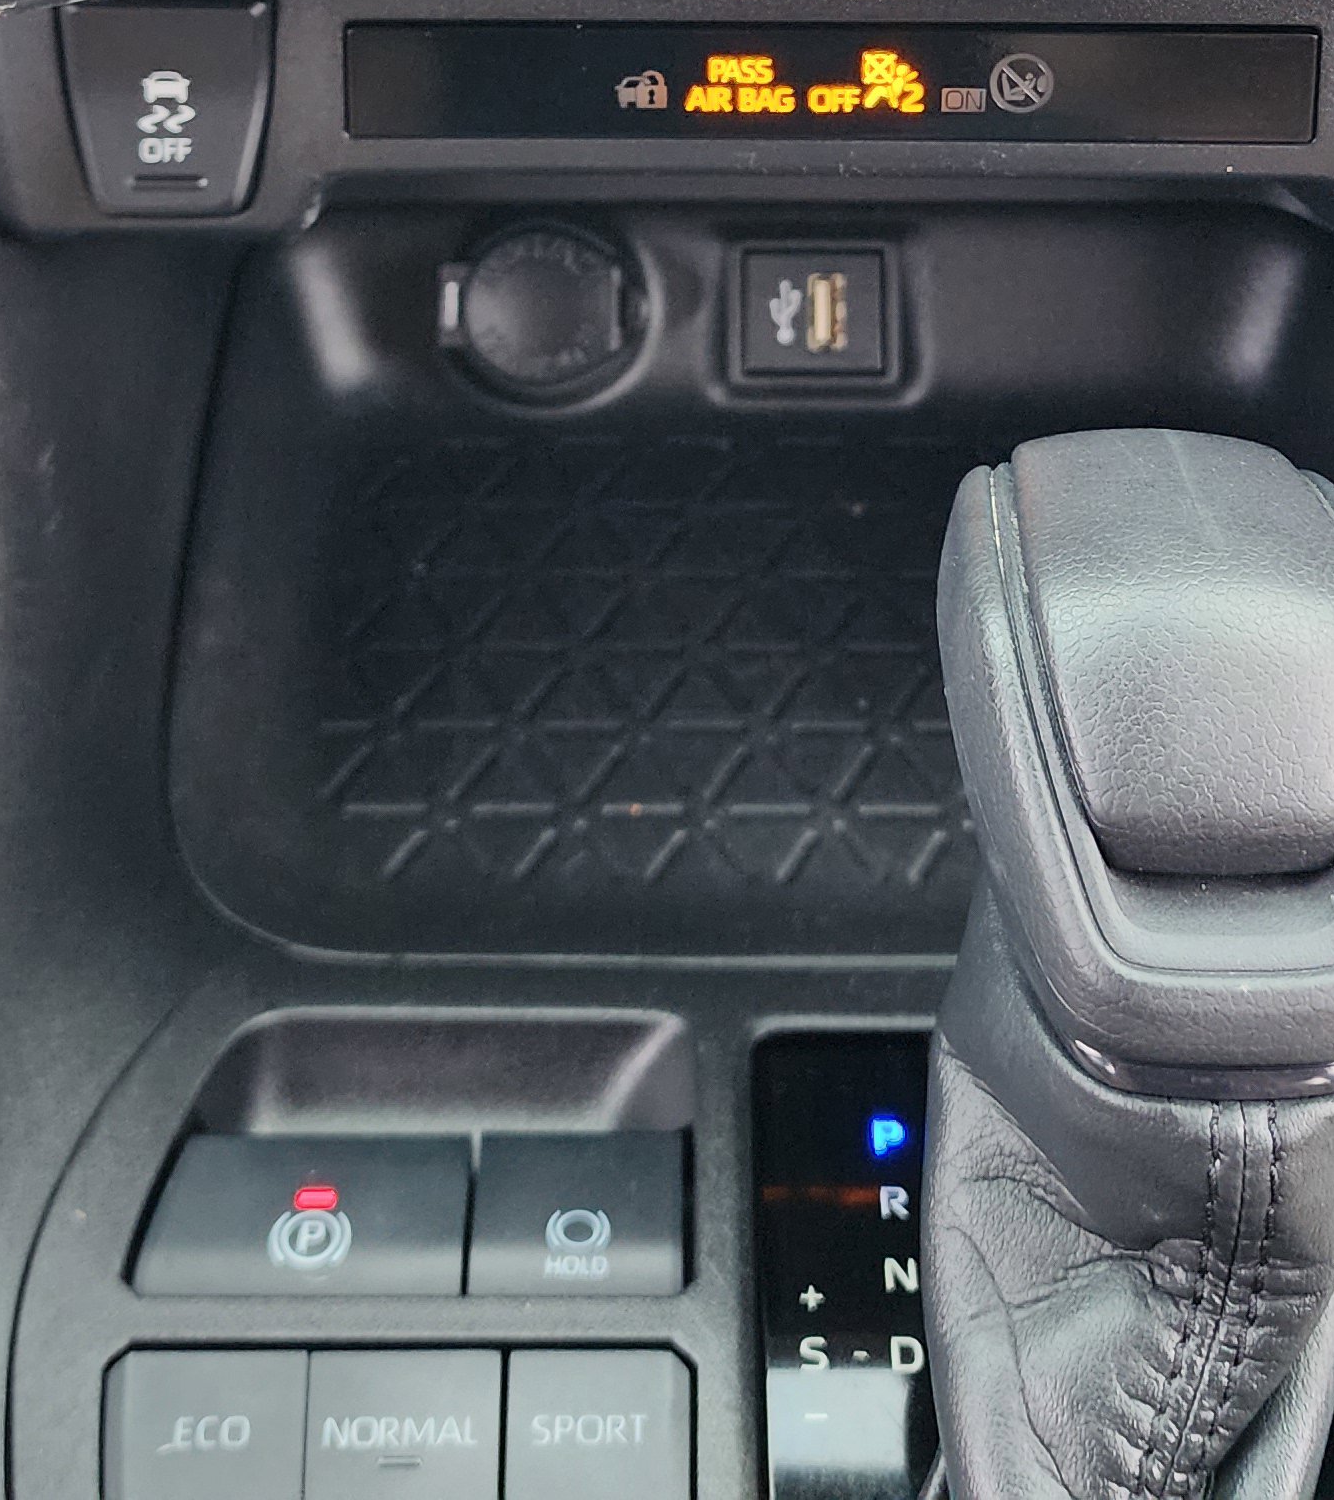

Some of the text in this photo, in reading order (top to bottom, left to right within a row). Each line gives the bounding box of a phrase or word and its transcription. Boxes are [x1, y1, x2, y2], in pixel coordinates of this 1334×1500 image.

[707, 55, 774, 84] PASS
[684, 85, 861, 113] AIR BAG OFF
[945, 90, 982, 111] ON
[138, 137, 192, 164] OFF
[871, 1117, 905, 1156] P
[879, 1186, 910, 1220] R
[543, 1256, 609, 1279] HOLD
[884, 1257, 918, 1292] N
[799, 1336, 830, 1372] S
[890, 1336, 925, 1374] D
[172, 1415, 250, 1451] ECO
[321, 1415, 478, 1450] NORMAL
[531, 1414, 647, 1445] SPORT
